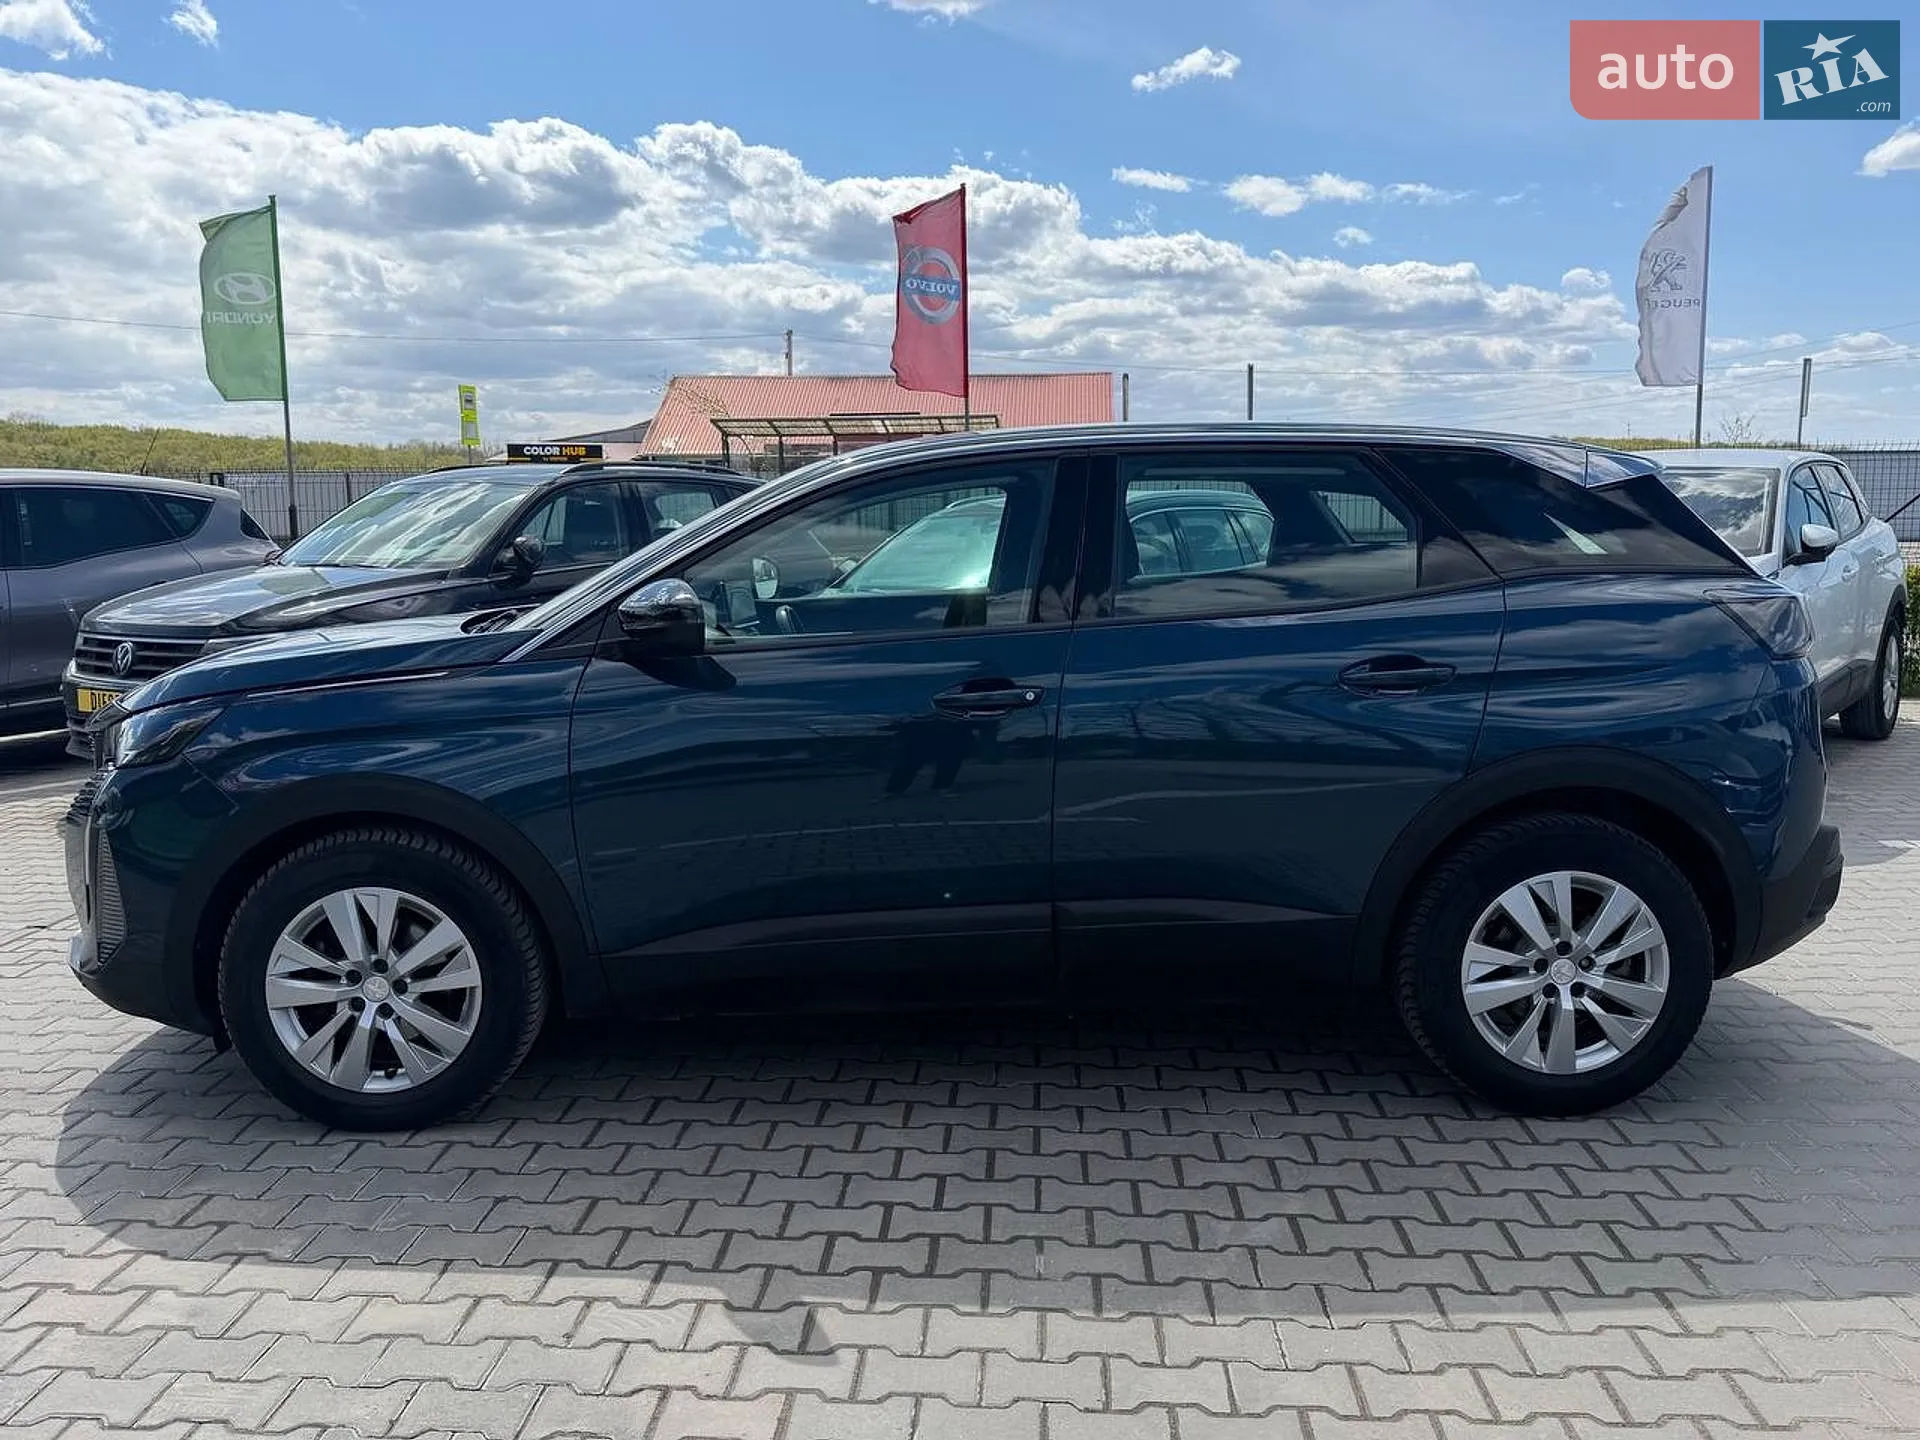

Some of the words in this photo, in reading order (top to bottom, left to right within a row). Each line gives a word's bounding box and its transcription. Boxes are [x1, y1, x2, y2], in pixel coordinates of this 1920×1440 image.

[523, 445, 560, 456] COLOR
[562, 446, 587, 456] HUB
[91, 692, 120, 710] DIE
